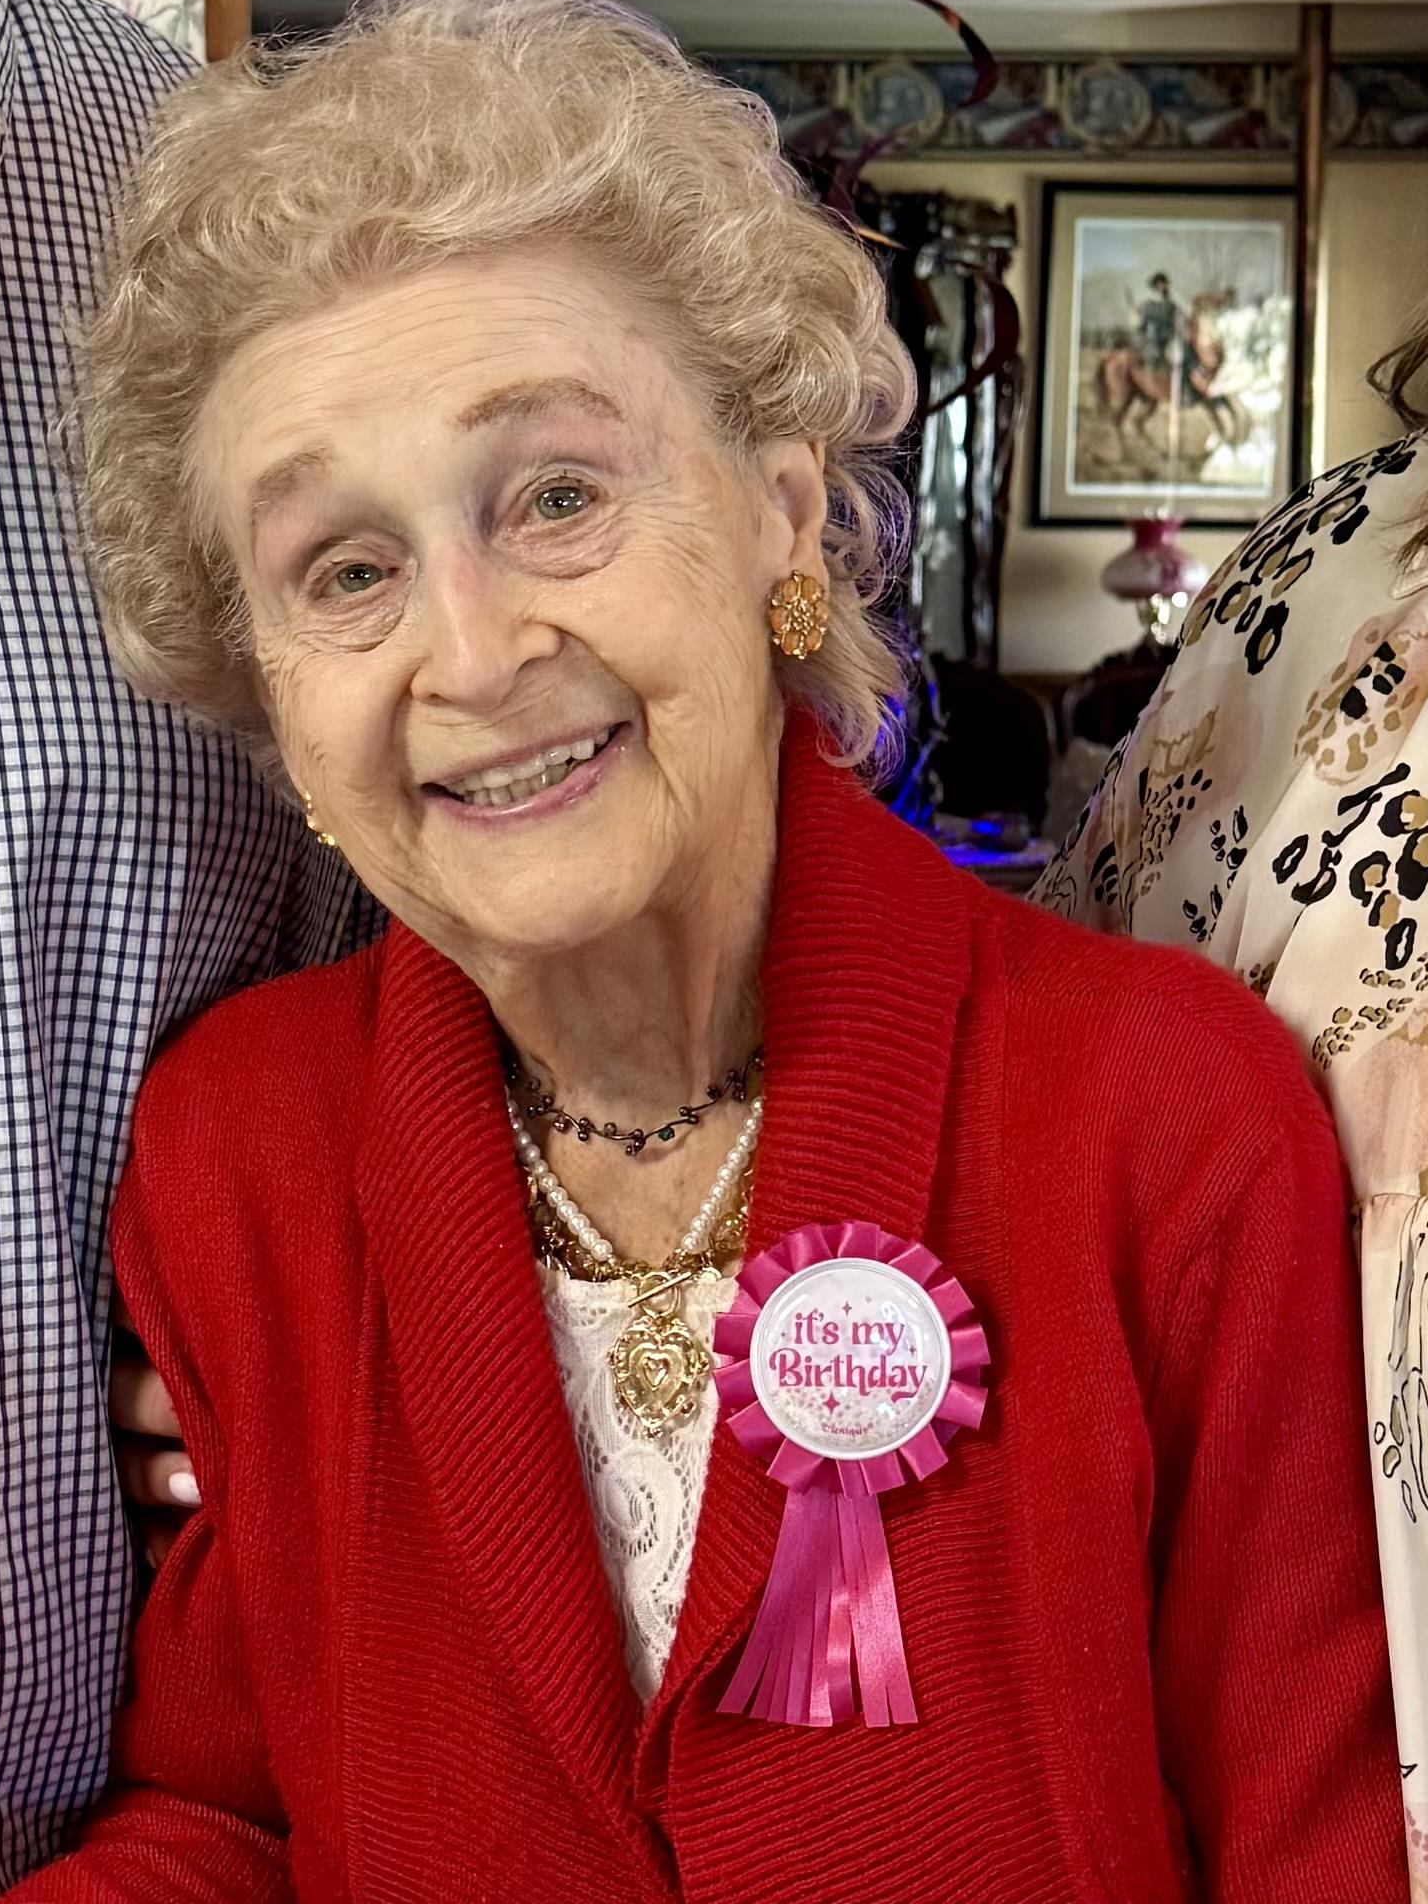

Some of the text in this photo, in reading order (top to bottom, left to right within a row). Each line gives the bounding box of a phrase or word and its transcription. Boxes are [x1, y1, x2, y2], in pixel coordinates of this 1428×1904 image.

[794, 1308, 905, 1356] it's my
[769, 1347, 928, 1404] Birthday
